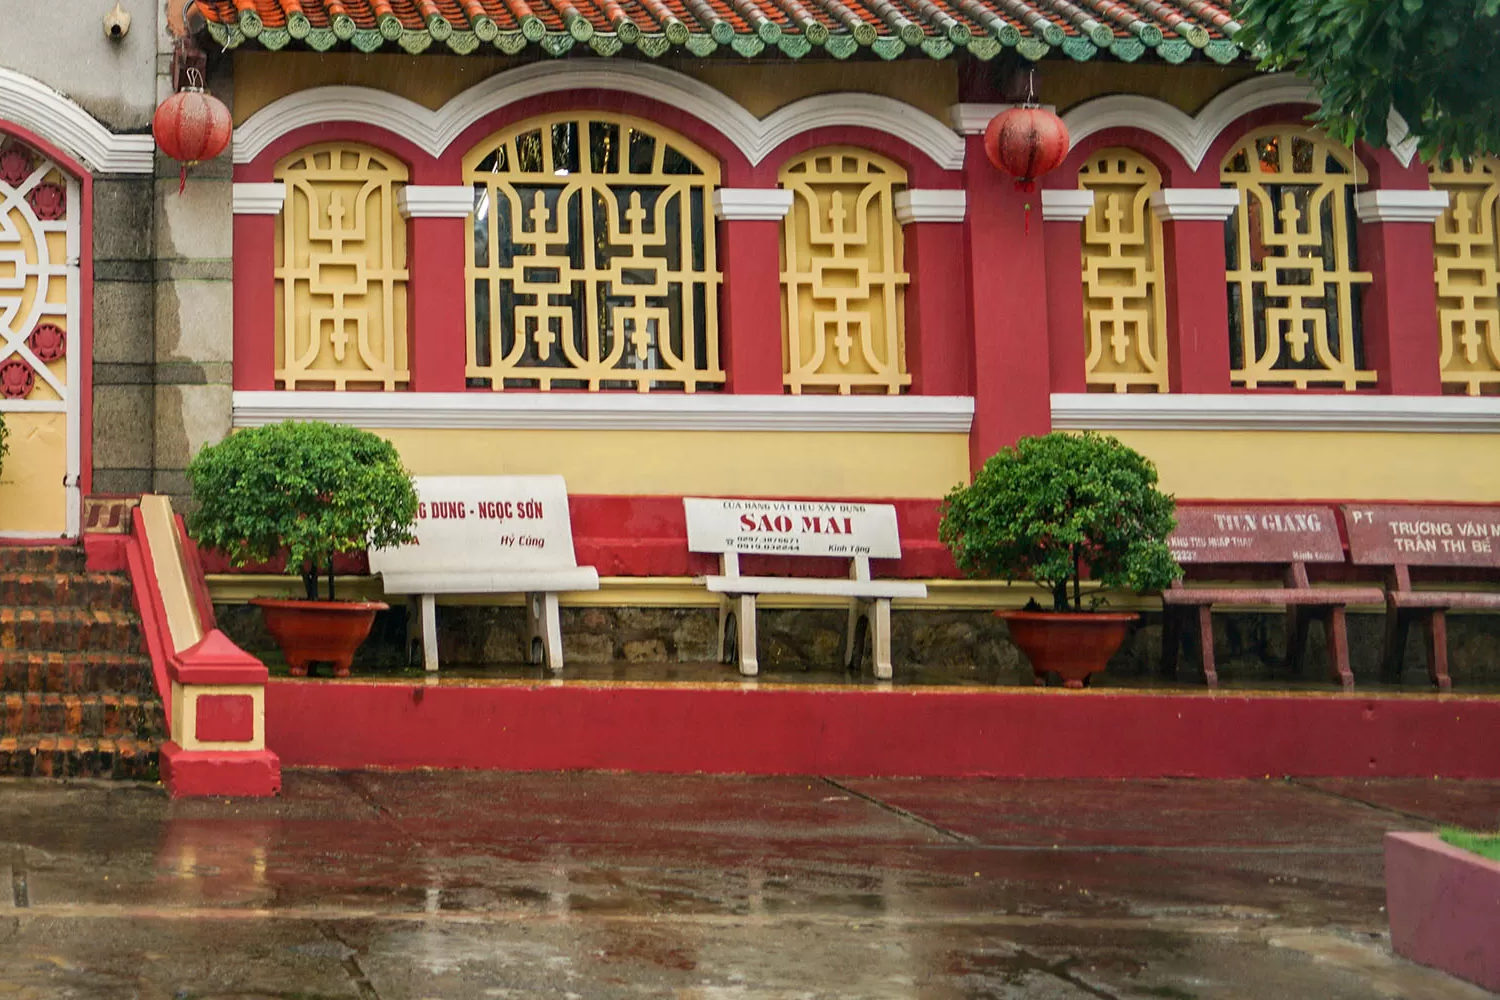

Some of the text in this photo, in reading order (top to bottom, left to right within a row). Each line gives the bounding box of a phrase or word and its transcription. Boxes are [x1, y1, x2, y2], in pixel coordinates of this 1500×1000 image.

[430, 501, 466, 519] DUNG
[478, 501, 513, 524] NGỌC
[517, 498, 543, 519] SƠN
[740, 513, 852, 534] SAO MAI
[1261, 513, 1322, 532] GIANG
